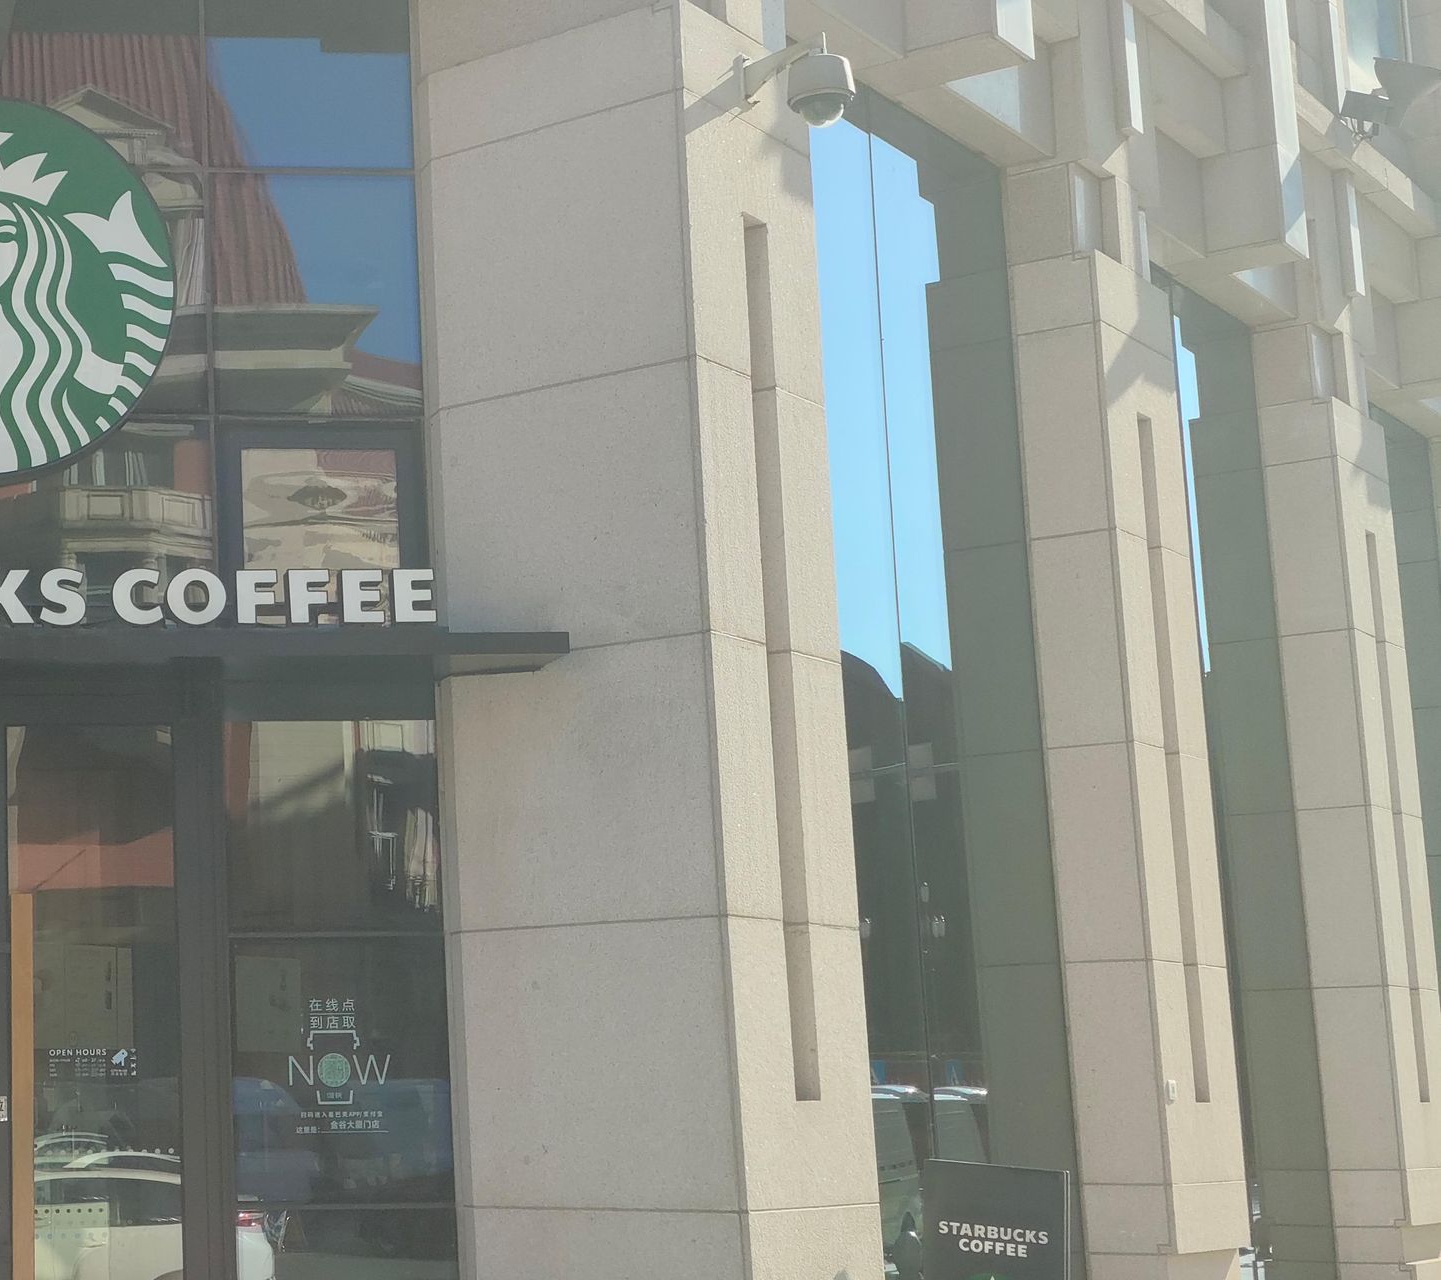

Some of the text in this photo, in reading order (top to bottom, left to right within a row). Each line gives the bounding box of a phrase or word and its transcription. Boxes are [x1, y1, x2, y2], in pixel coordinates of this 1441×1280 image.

[110, 567, 438, 625] COFFEE
[309, 999, 355, 1012] 在线点
[310, 1016, 356, 1029] 到店取
[49, 1048, 107, 1057] OPEN HOURS
[938, 1221, 1049, 1245] STARBUCKS
[958, 1238, 1028, 1258] COFFEE
